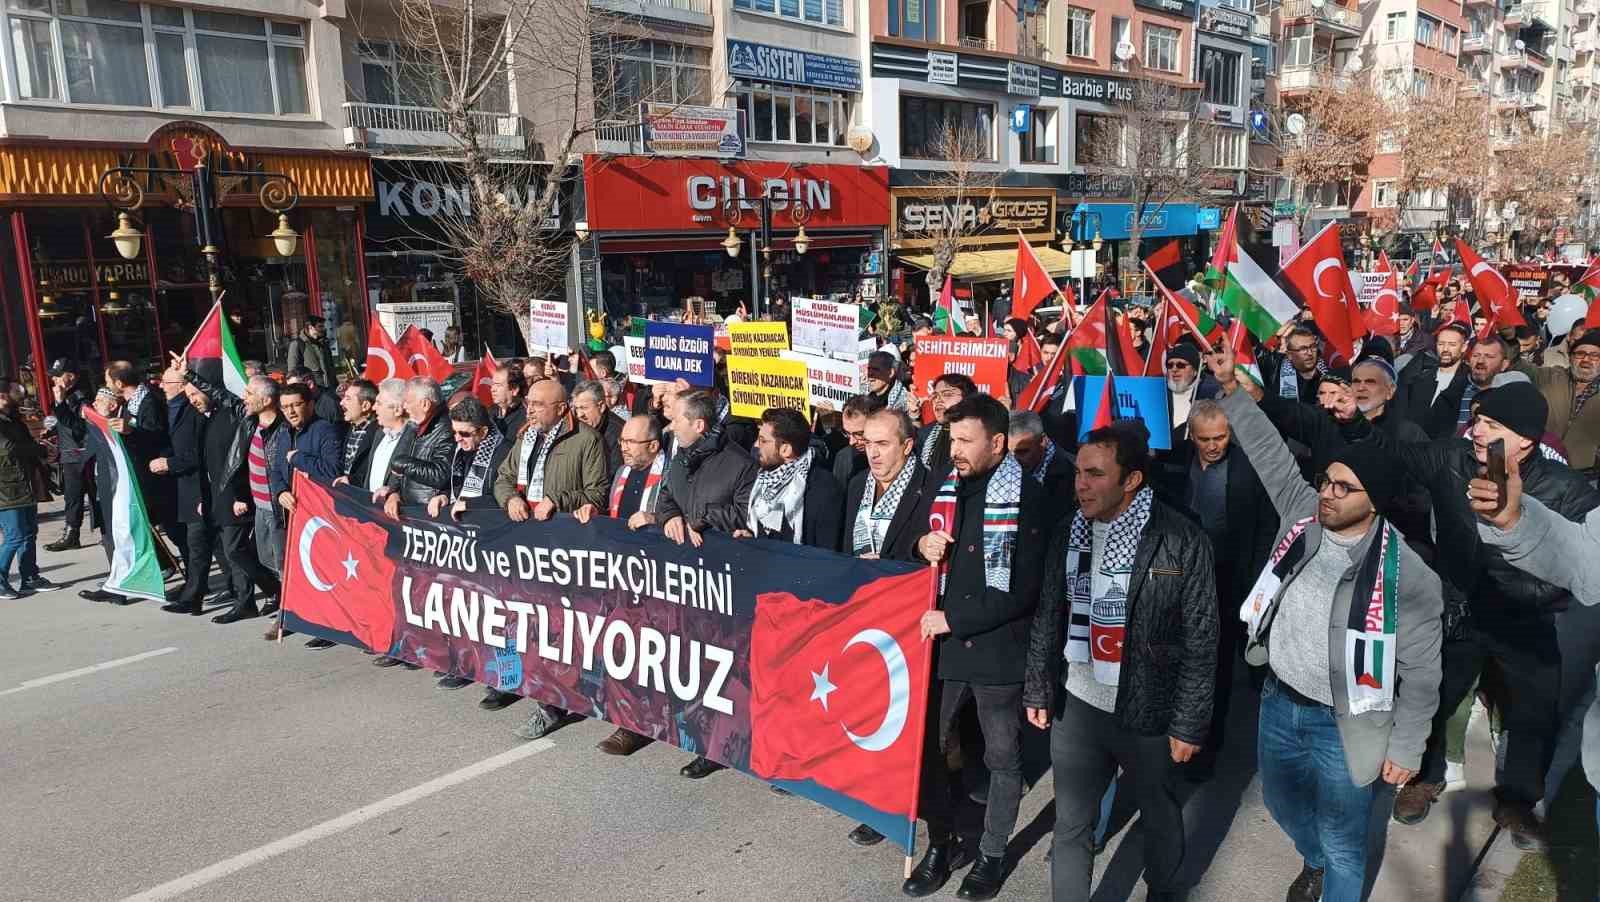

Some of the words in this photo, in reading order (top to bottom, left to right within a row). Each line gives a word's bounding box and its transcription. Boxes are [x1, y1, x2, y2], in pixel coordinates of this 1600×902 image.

[1063, 76, 1103, 98] Barbie
[1107, 81, 1132, 100] Plus
[905, 203, 976, 232] SENA
[992, 200, 1048, 217] GROSS
[649, 335, 677, 352] KUDÜS
[679, 336, 709, 354] ÖZGÜR
[655, 355, 682, 371] OLANA
[684, 358, 702, 373] DEK
[760, 372, 804, 391] KAZANACAK
[825, 369, 853, 388] ÖLMEZ
[732, 388, 766, 406] SİYONİZM
[402, 525, 478, 573] TERÖRÜ
[482, 550, 511, 576] ve
[515, 544, 733, 616] DESTEKÇİLERİNİ
[402, 576, 735, 716] LANETLİYORUZ
